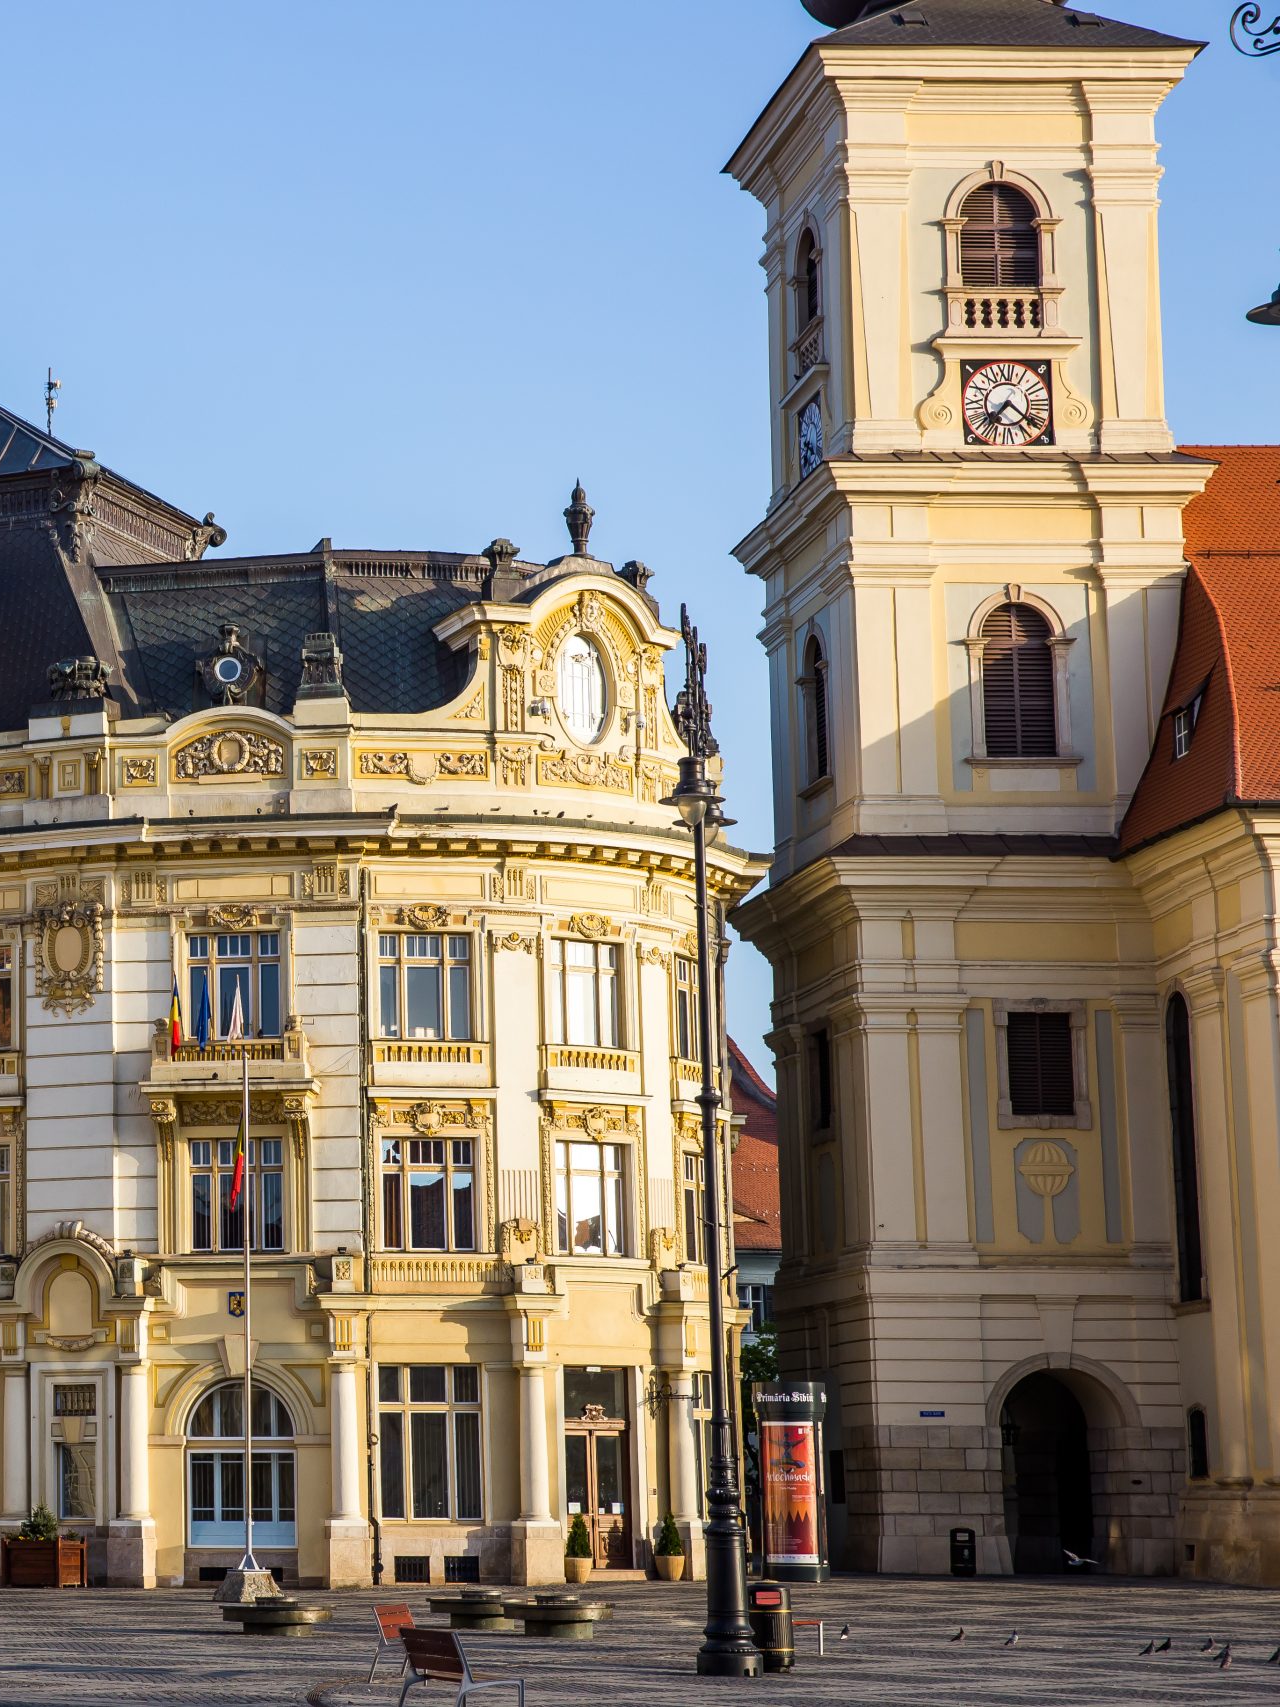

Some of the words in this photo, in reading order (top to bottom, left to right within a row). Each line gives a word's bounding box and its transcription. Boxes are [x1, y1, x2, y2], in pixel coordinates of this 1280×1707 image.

[965, 364, 974, 374] 1
[979, 368, 998, 385] XI
[997, 364, 1015, 382] XII
[1017, 368, 1028, 384] I
[1037, 364, 1047, 374] 8
[968, 380, 988, 396] X
[1025, 380, 1044, 396] II
[965, 397, 984, 410] IX
[1030, 398, 1049, 411] III
[967, 434, 976, 443] 6
[1002, 427, 1015, 445] VI
[1018, 423, 1032, 441] V
[791, 1391, 814, 1403] Sibiu
